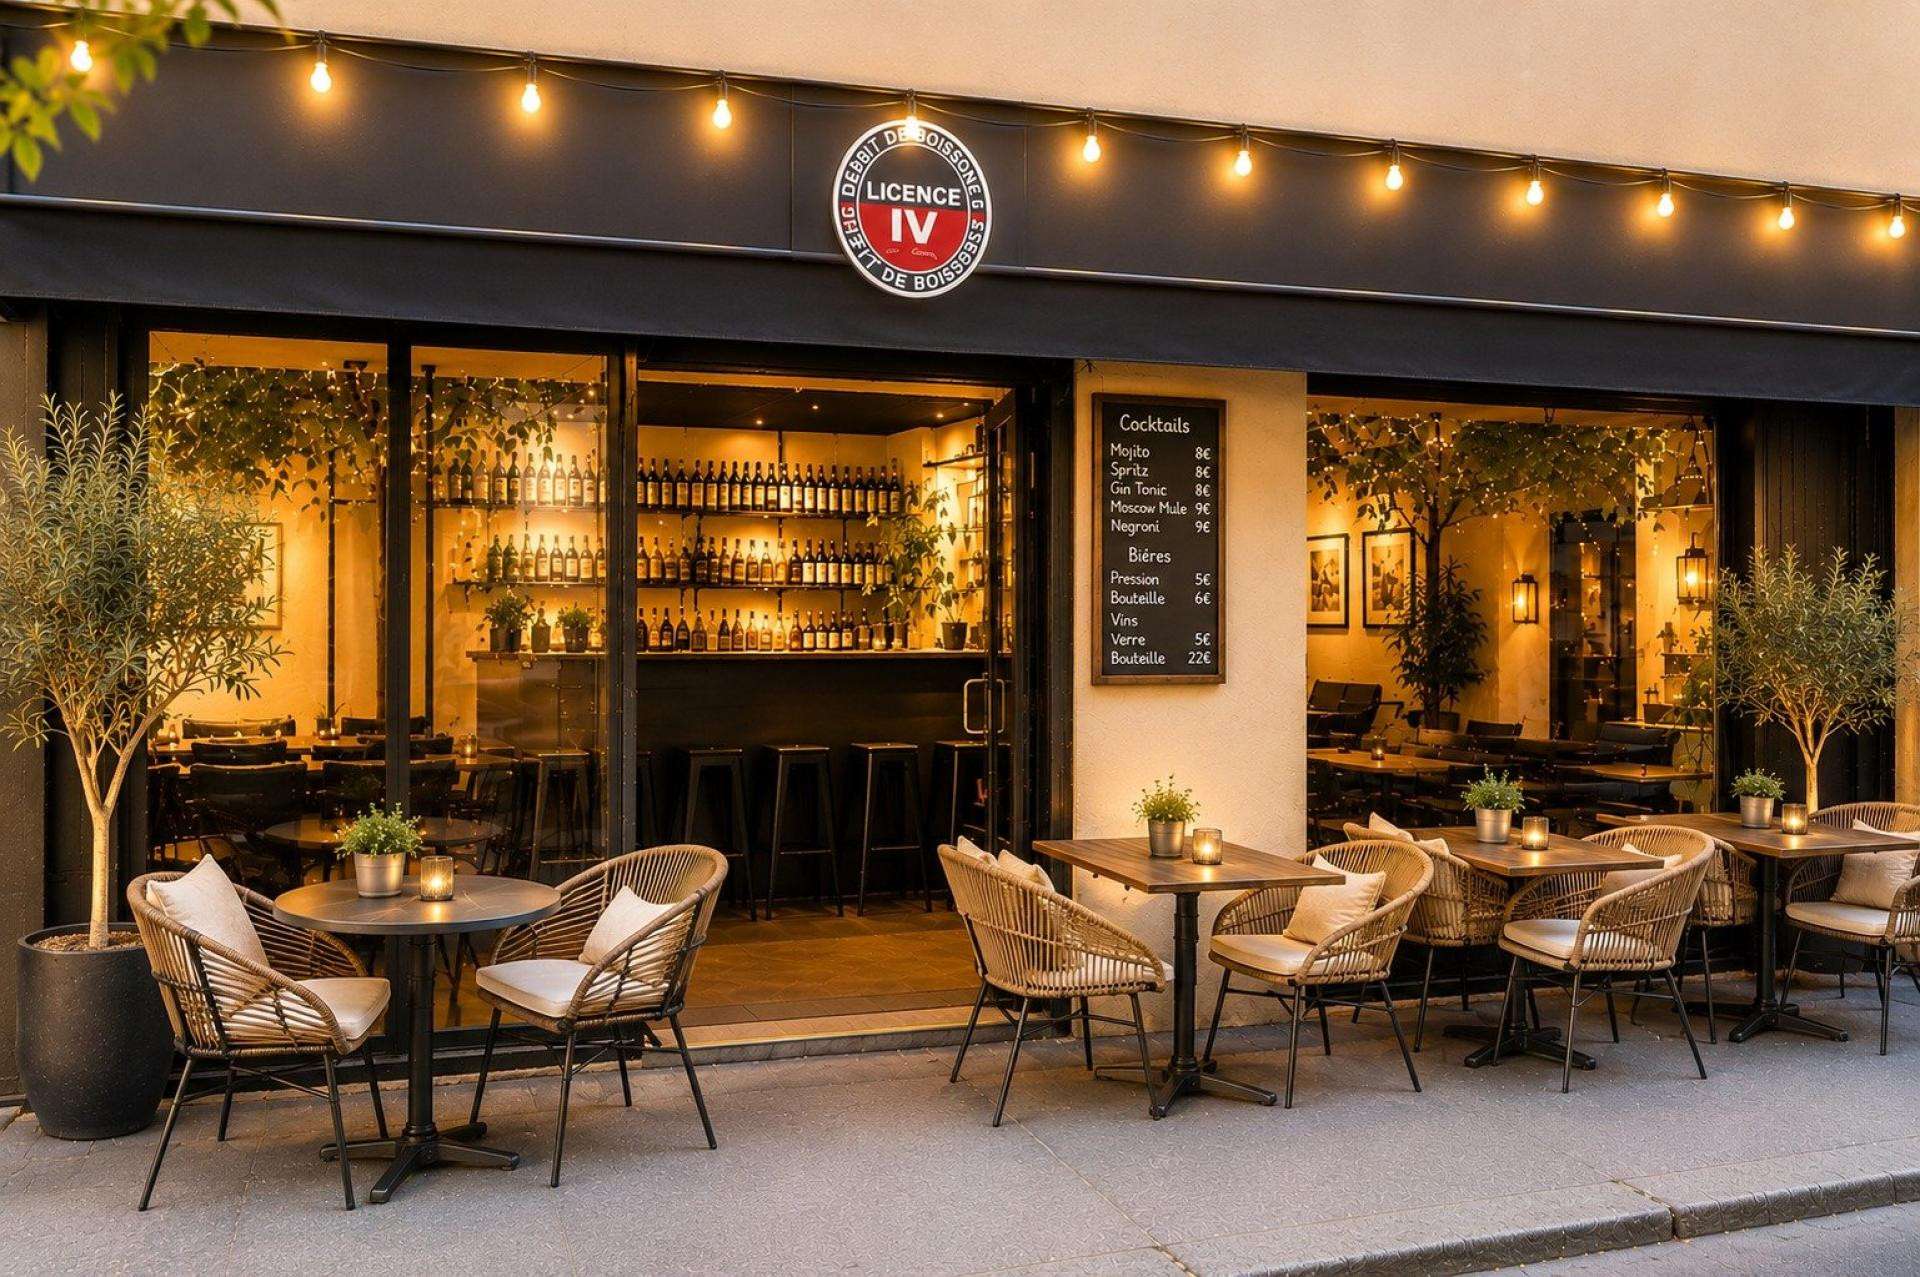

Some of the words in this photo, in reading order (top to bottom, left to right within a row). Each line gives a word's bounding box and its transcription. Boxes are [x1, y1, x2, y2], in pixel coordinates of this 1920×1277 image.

[866, 180, 962, 206] LICENCE
[891, 208, 938, 244] IV
[881, 267, 907, 289] DE
[1119, 413, 1190, 434] Cocktails
[1110, 443, 1150, 462] Mojito
[1194, 446, 1212, 461] 8€
[1110, 461, 1149, 480] Spritz
[1194, 465, 1212, 479] 8€
[1110, 481, 1131, 495] Gin
[1135, 481, 1168, 497] Tonic
[1194, 483, 1212, 498] 8€
[1110, 500, 1156, 514] Moscow
[1158, 501, 1188, 515] Mule
[1194, 502, 1212, 516] 9€
[1111, 519, 1161, 538] Negroni
[1194, 520, 1211, 534] 9€
[1110, 570, 1160, 586] Pression
[1194, 572, 1212, 587] 5€
[1110, 590, 1166, 605] Bouteille
[1194, 591, 1212, 606] 6€
[1110, 613, 1139, 627] Vins
[1110, 633, 1146, 647] Verre
[1194, 632, 1212, 647] 5€
[1111, 651, 1166, 665] Bouteille
[1187, 651, 1212, 665] 22€
